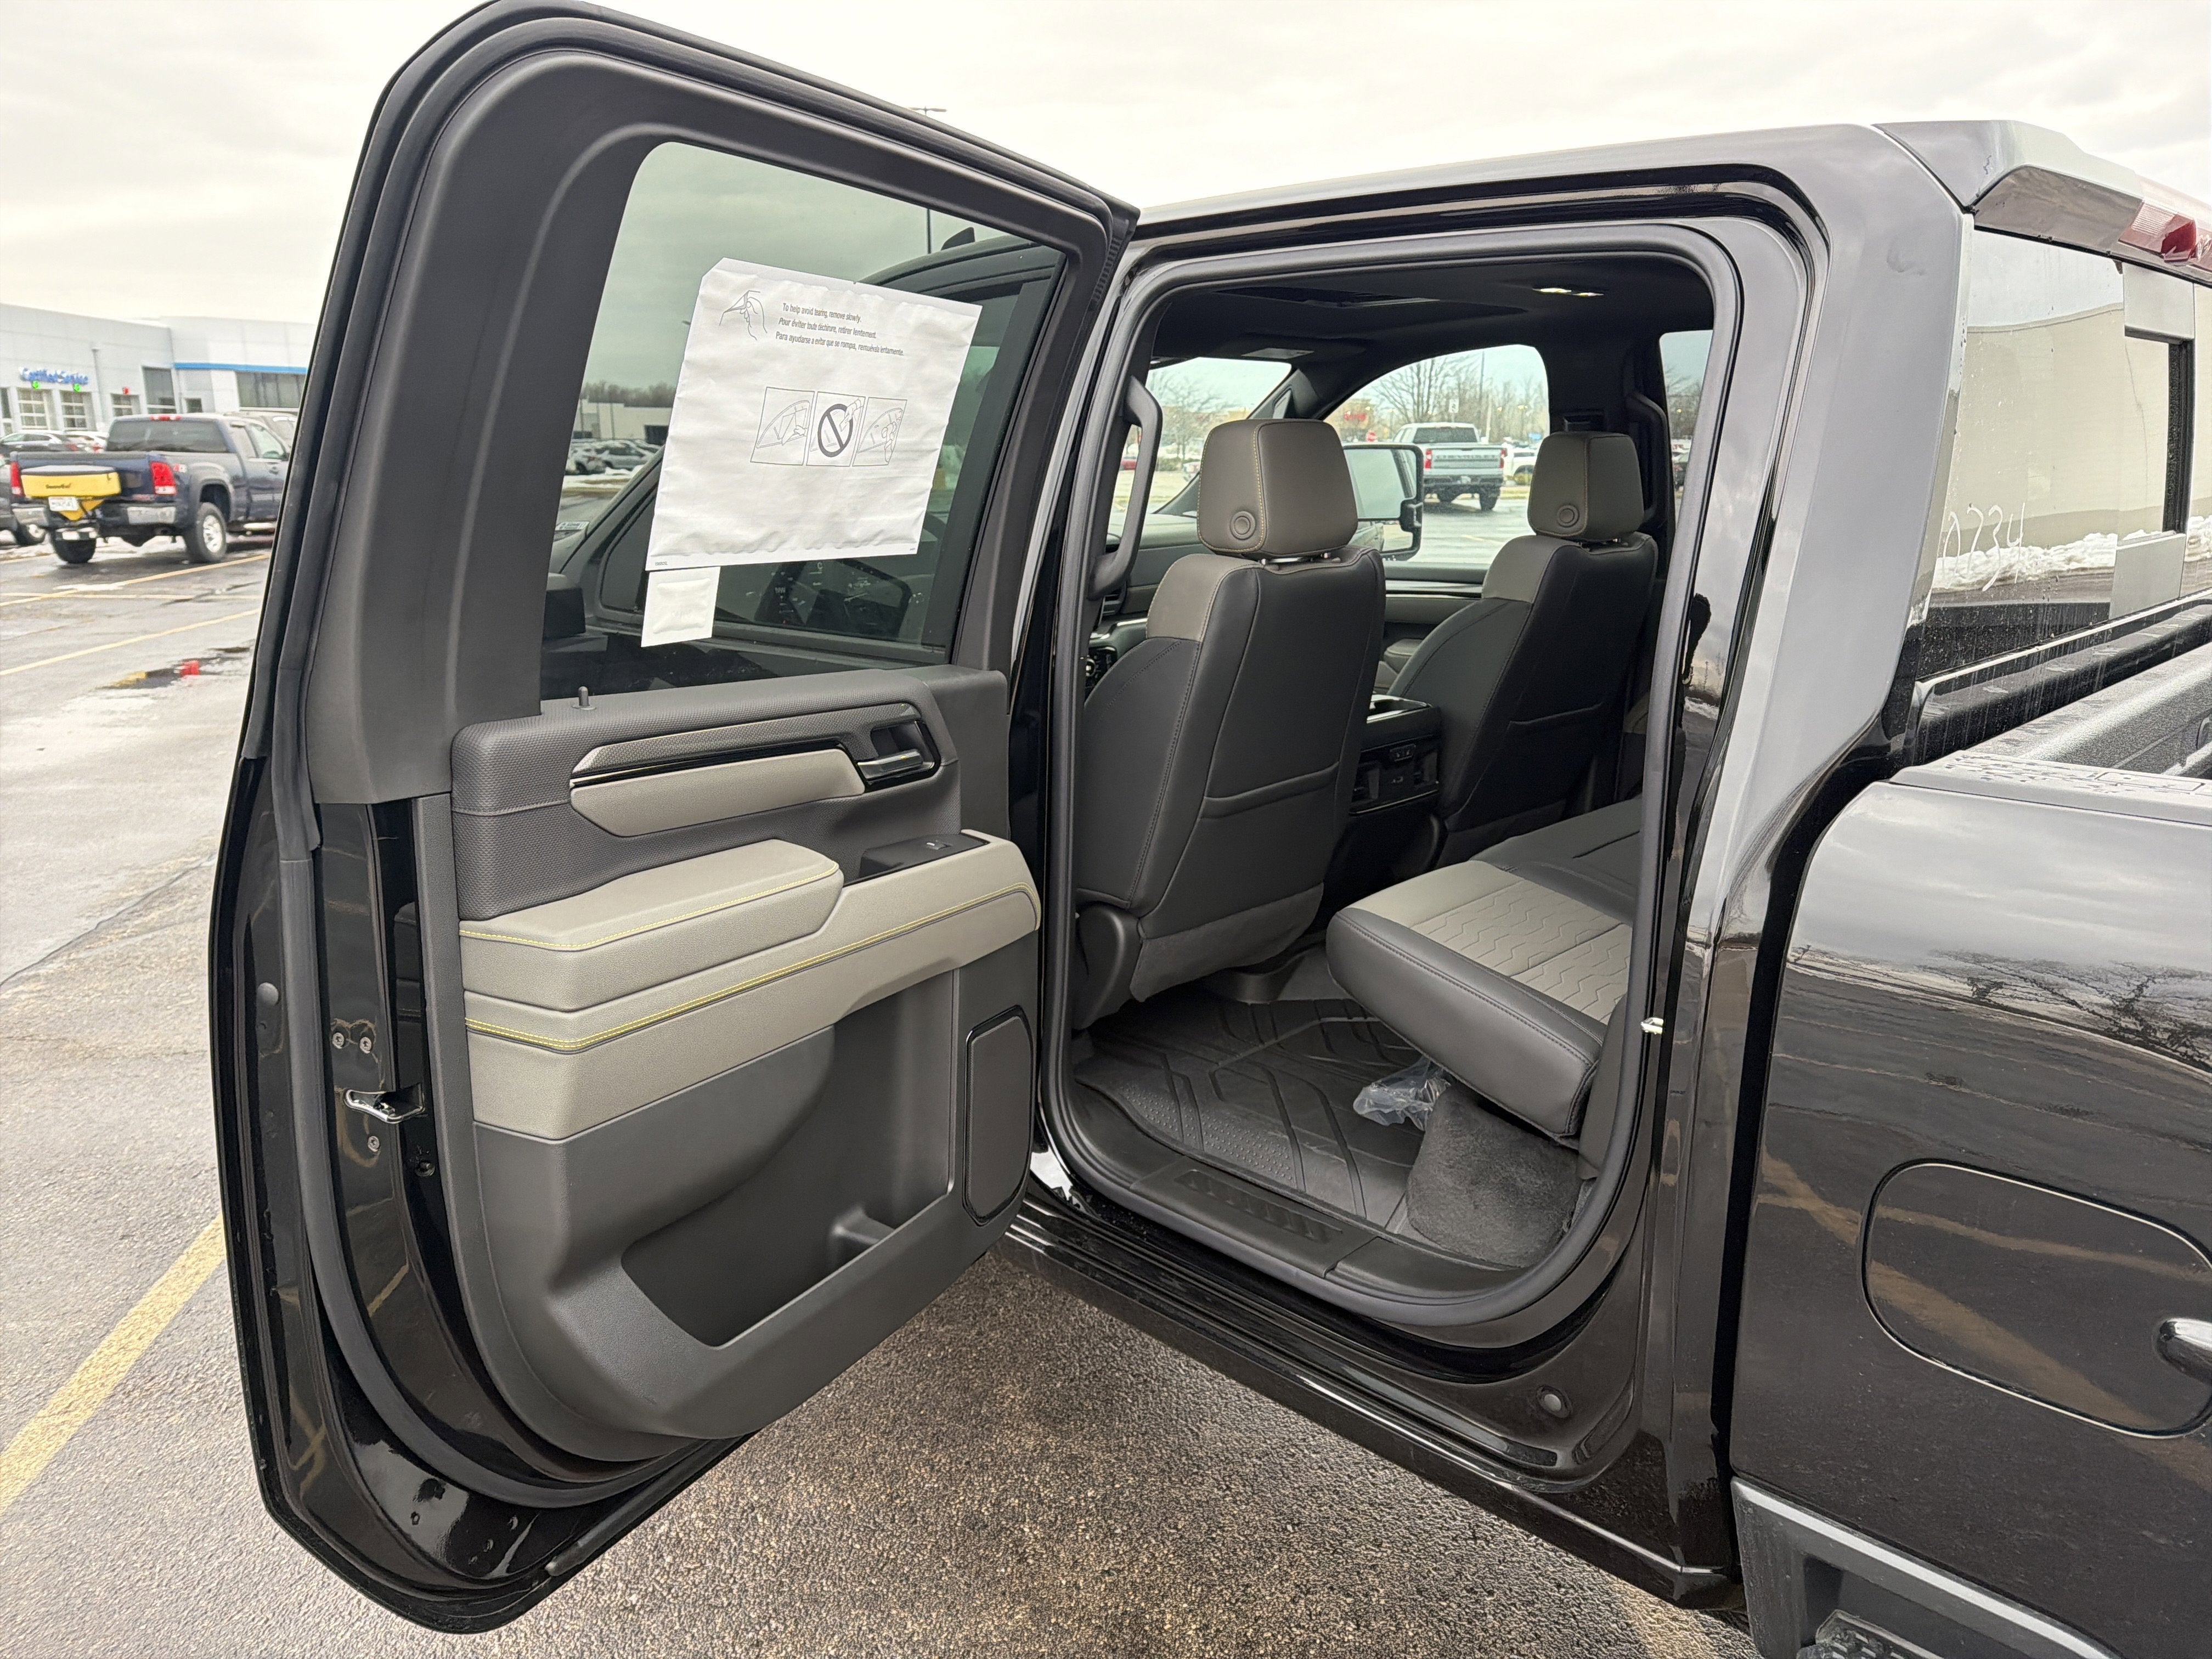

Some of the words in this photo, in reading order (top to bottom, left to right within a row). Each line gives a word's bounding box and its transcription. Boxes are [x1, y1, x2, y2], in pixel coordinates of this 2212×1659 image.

[783, 303, 789, 311] To
[790, 304, 800, 315] help
[802, 307, 814, 315] avoid
[829, 312, 845, 320] remove
[845, 313, 862, 324] slowly.
[778, 317, 791, 326] Pour
[792, 319, 807, 329] éviter
[807, 321, 817, 330] toute
[838, 326, 853, 335] retirer
[775, 331, 788, 341] Para
[789, 334, 811, 344] ayudarse
[815, 337, 826, 346] evitar
[826, 340, 834, 348] que
[840, 341, 856, 351] rompa,
[880, 346, 905, 356] lentamente.
